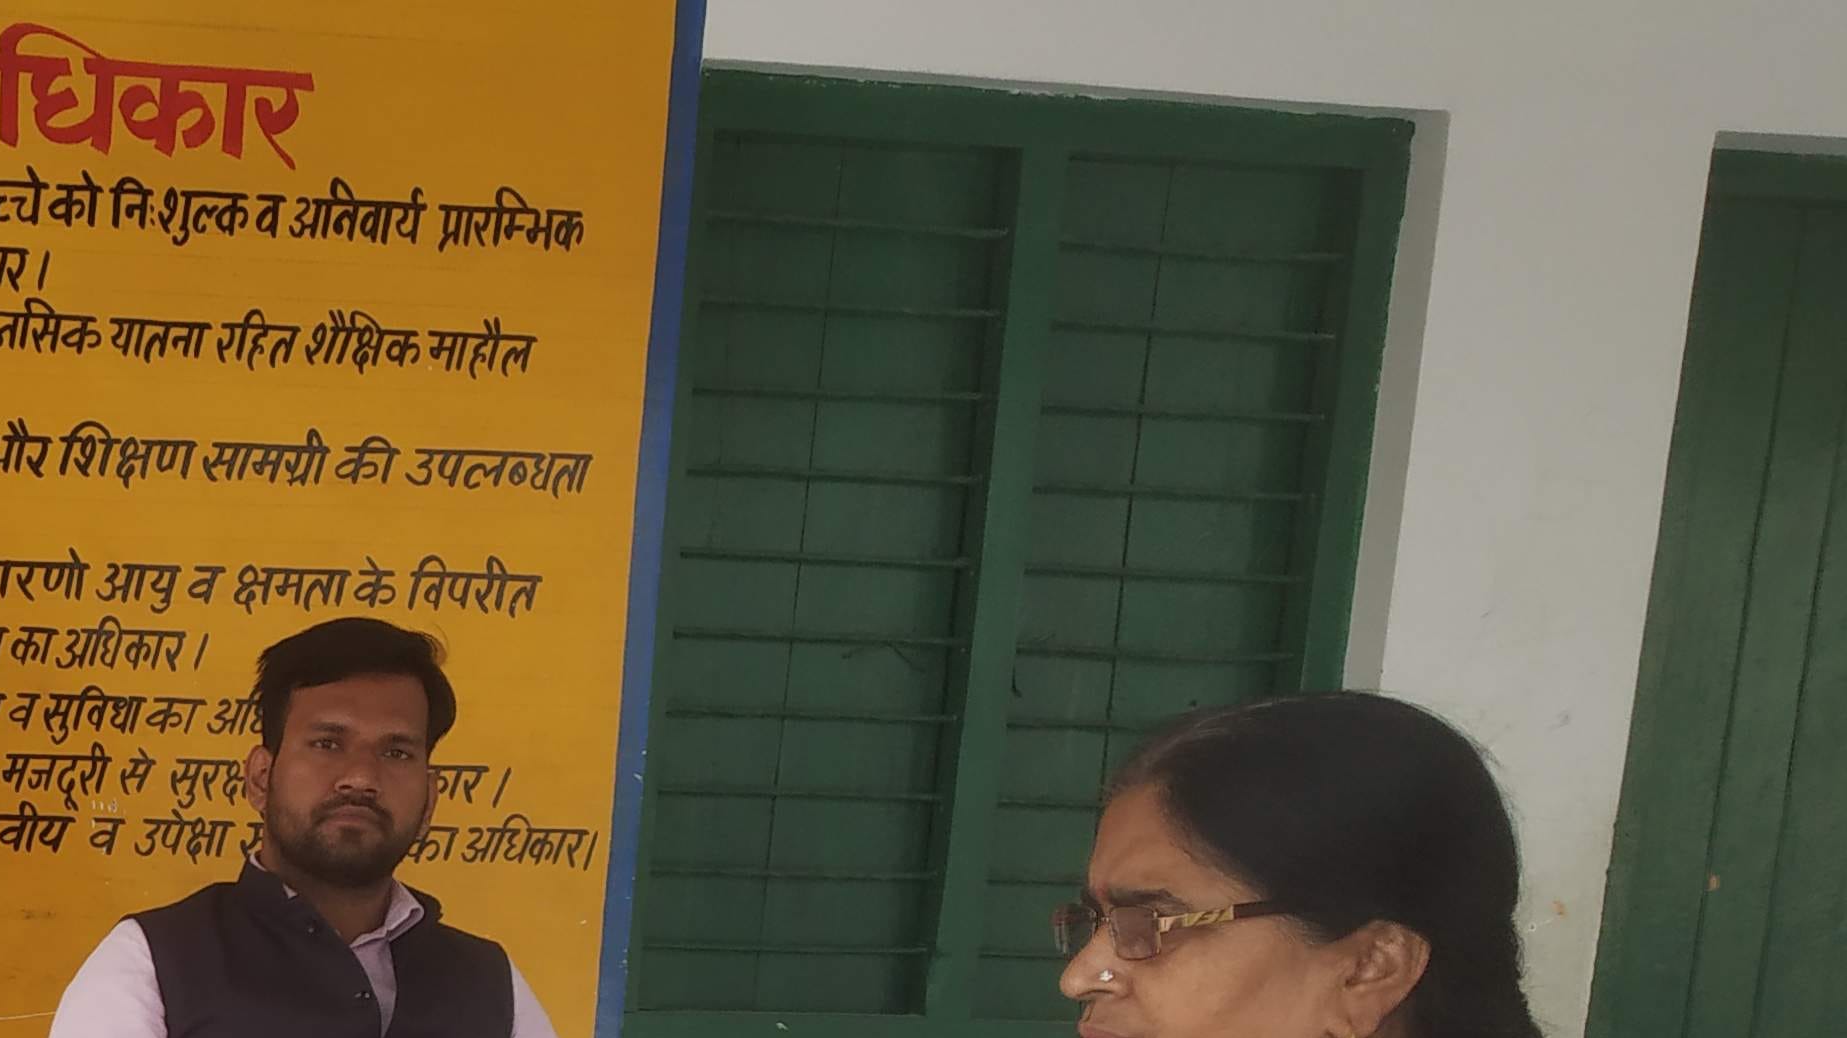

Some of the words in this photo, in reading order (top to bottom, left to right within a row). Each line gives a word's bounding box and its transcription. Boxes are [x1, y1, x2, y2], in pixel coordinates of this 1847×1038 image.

[48, 170, 104, 228] को
[255, 194, 287, 238] व
[288, 178, 427, 245] अनिवार्य
[438, 187, 585, 253] प्रारम्भिक
[109, 316, 212, 364] यातना
[217, 309, 301, 371] रहित
[428, 316, 538, 380] माहौल
[58, 420, 198, 489] शिक्षण
[202, 428, 332, 487] सामग्री
[335, 435, 402, 485] की
[405, 447, 594, 499] उपलब्धता
[96, 562, 182, 614] आयु
[187, 565, 226, 605] व
[233, 563, 352, 615] क्षमता
[353, 556, 397, 610] के
[407, 554, 544, 618] विपरीत
[10, 626, 60, 666] का
[8, 692, 41, 732] व
[43, 684, 148, 746] सुविधा
[146, 697, 208, 735] का
[1, 741, 112, 811] मजदूरी
[119, 747, 157, 796] से
[89, 815, 126, 856] व
[134, 808, 237, 865] उपेक्षा
[406, 826, 460, 864] का
